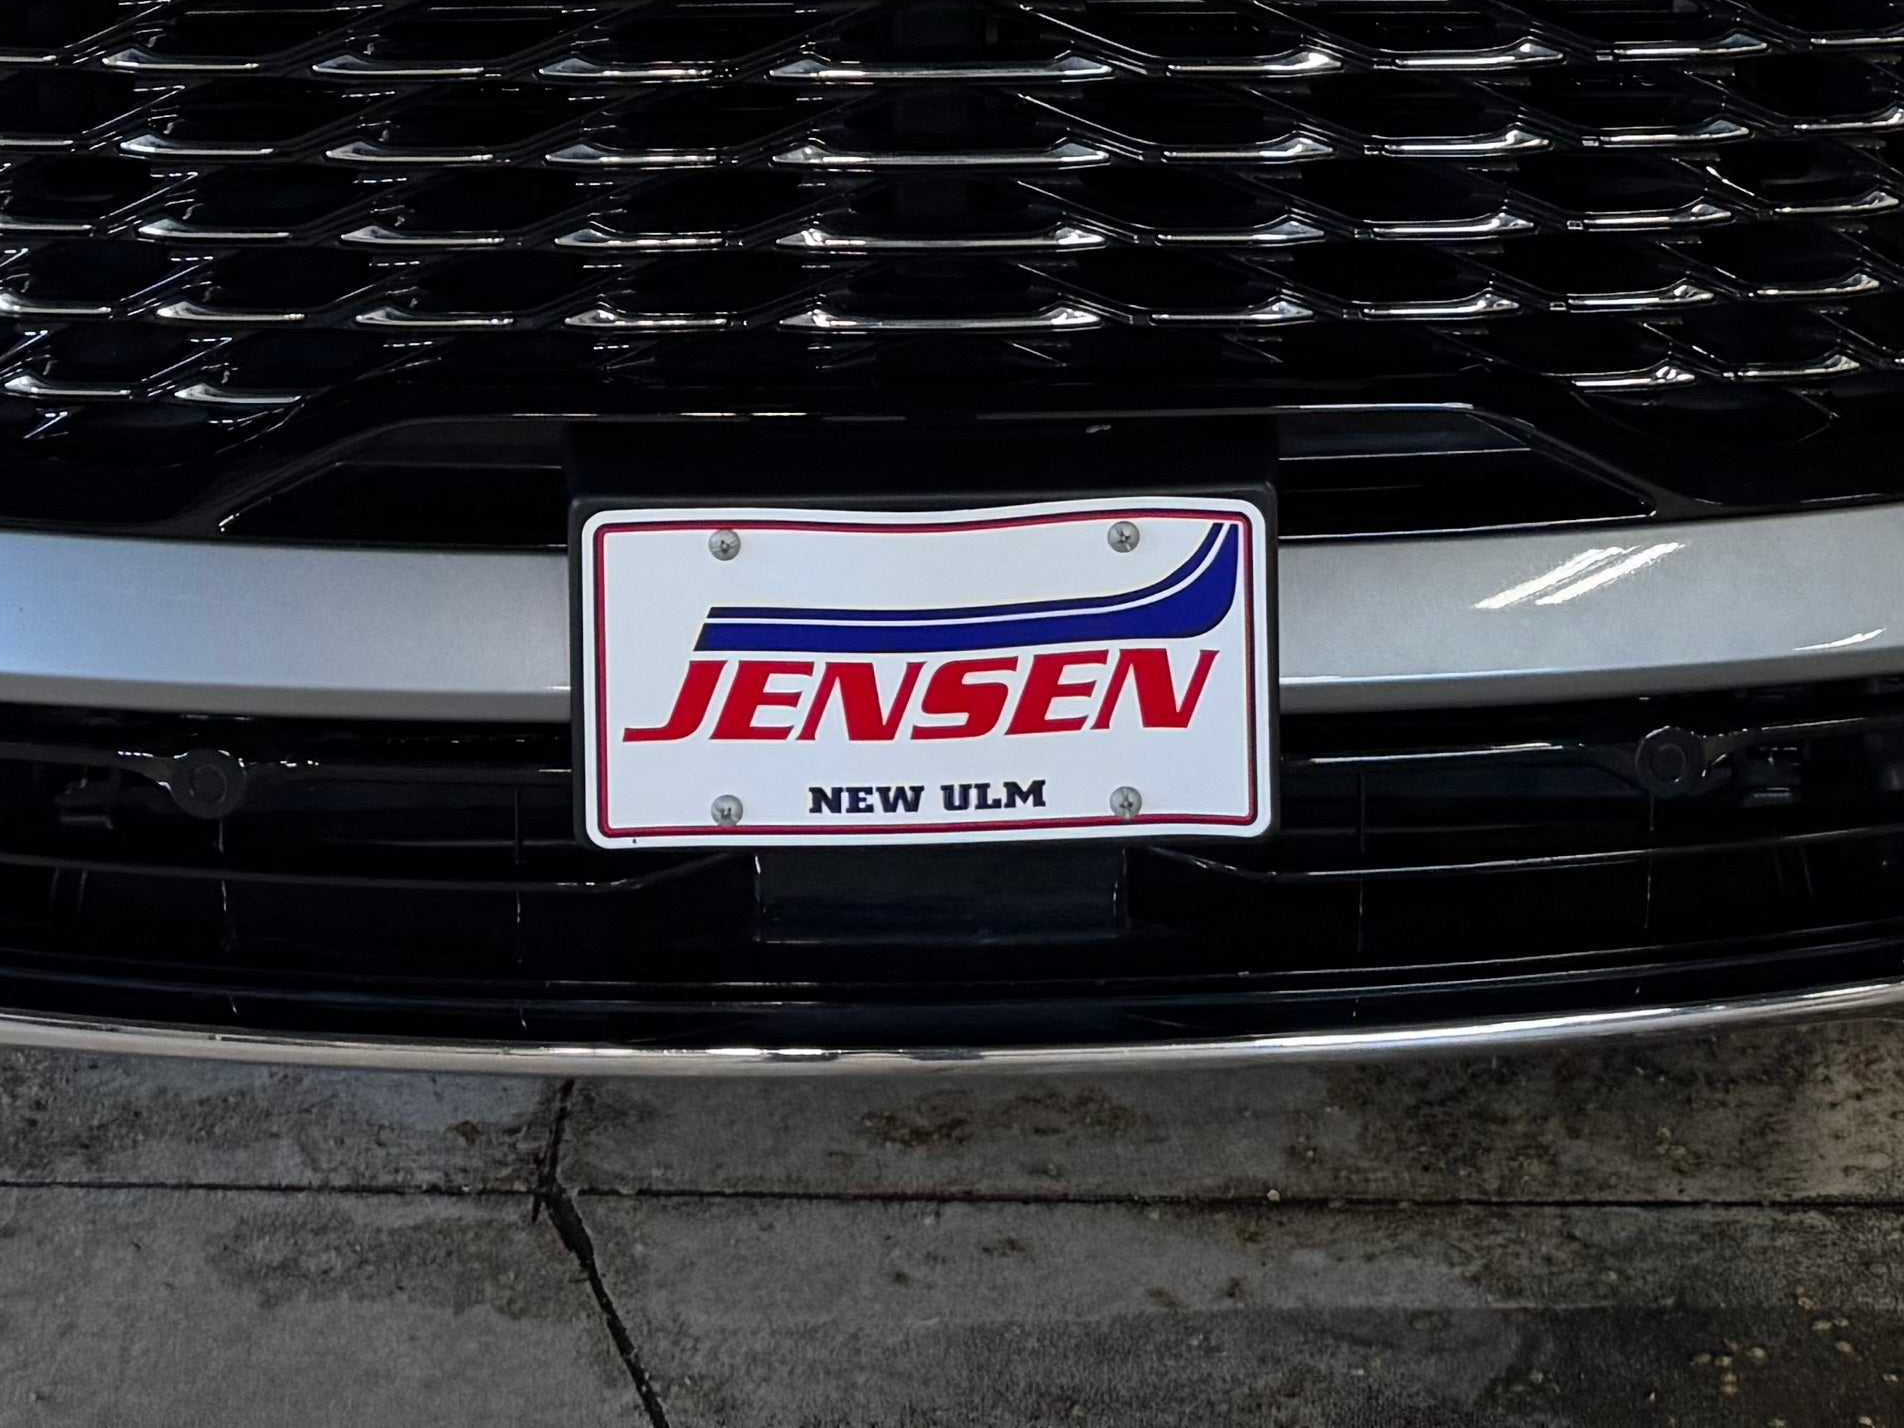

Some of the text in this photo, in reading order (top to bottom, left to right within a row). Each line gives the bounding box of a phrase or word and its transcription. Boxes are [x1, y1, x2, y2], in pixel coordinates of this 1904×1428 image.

[622, 647, 1218, 743] JENSEN
[807, 779, 1047, 814] NEW ULM
